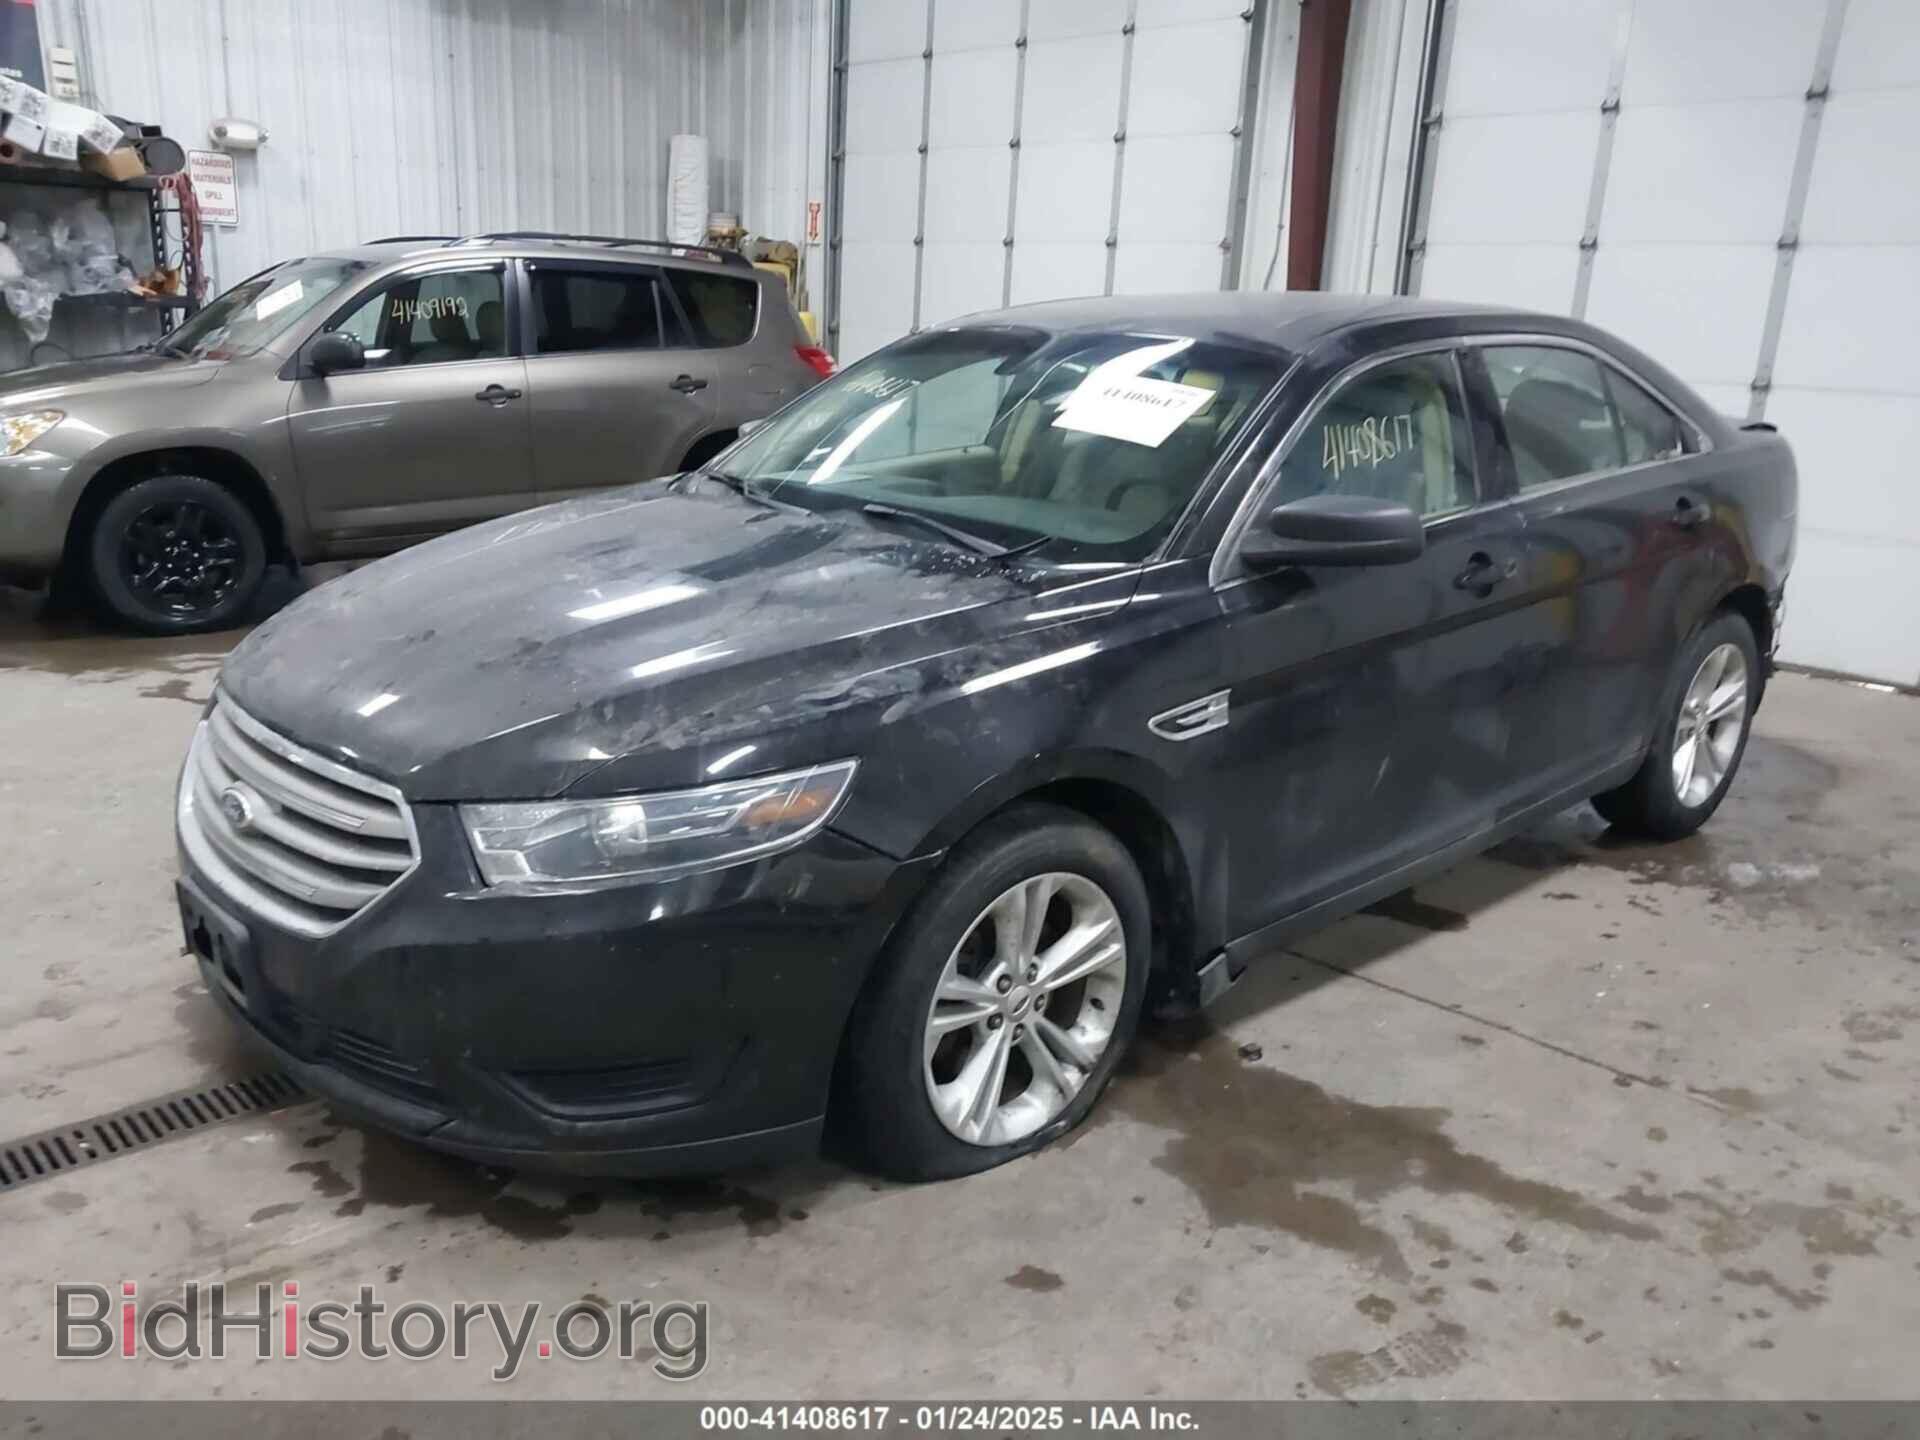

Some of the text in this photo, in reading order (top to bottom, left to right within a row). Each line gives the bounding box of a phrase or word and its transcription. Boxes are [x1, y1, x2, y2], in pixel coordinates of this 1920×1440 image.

[193, 173, 232, 185] MATERIALS
[204, 190, 224, 200] SPILL
[1322, 414, 1414, 480] 41408617
